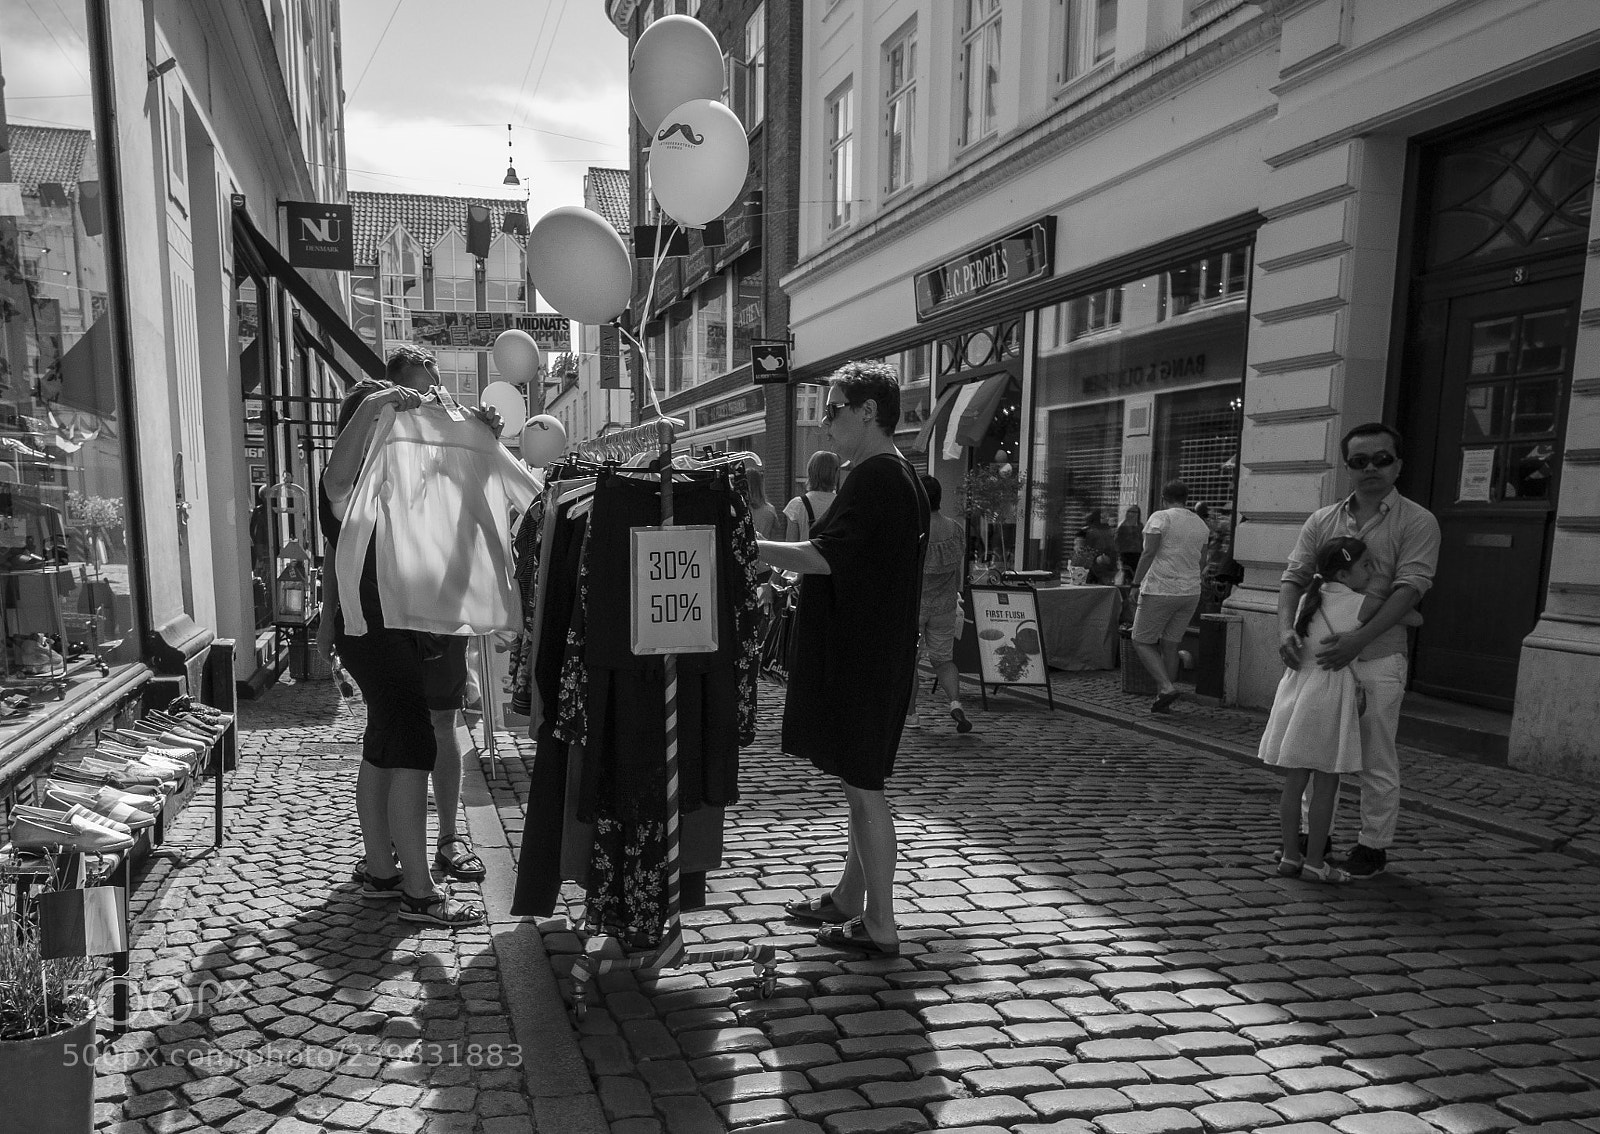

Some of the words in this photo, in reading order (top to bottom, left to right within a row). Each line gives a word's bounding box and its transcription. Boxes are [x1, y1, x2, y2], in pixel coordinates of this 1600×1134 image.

[298, 212, 342, 242] NÜ
[305, 245, 339, 253] DENMARK
[963, 248, 1008, 293] PERCH'S
[1514, 266, 1523, 282] 3
[516, 317, 570, 331] MIDNATS
[526, 330, 570, 342] OPPING
[649, 550, 700, 580] 30%
[651, 593, 702, 623] 50%
[985, 609, 1003, 619] FIRST
[1005, 610, 1026, 619] FLUSH
